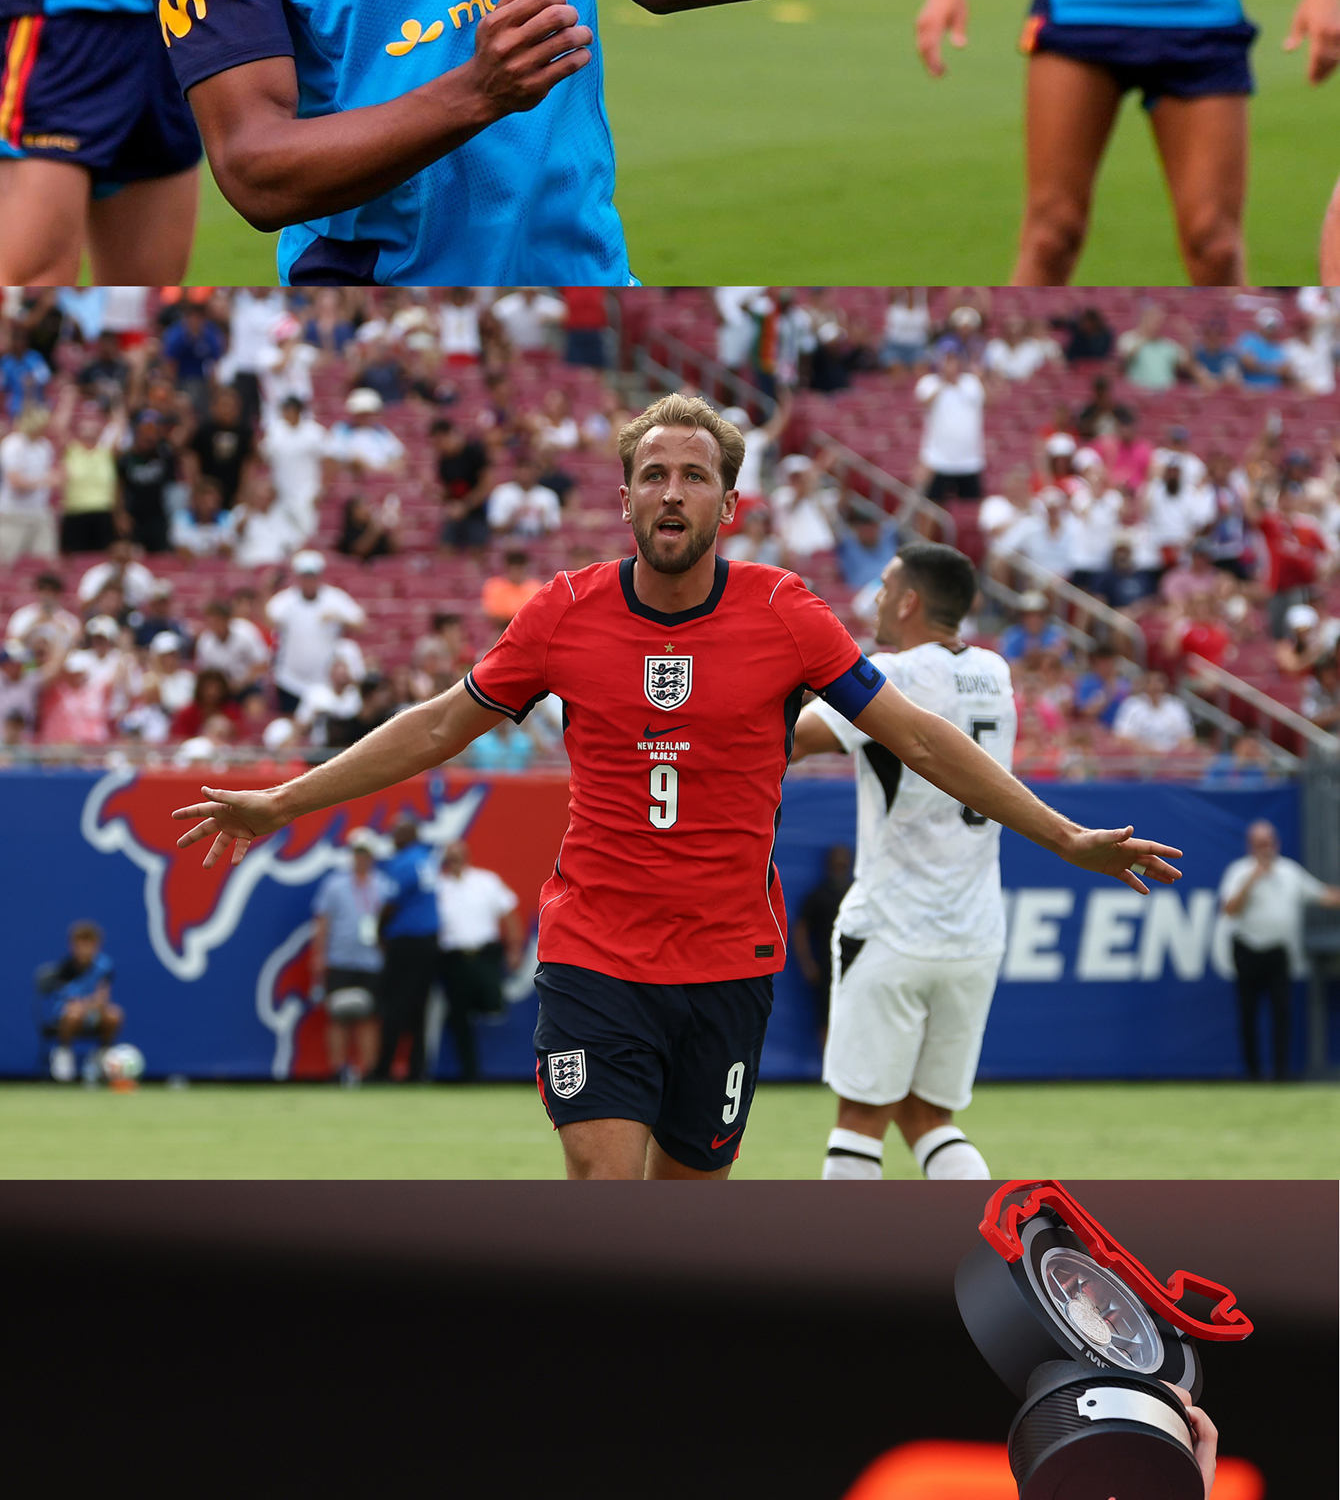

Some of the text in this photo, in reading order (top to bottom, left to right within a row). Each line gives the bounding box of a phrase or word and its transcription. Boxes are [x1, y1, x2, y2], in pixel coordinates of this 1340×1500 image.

[851, 659, 881, 690] C
[637, 742, 690, 751] NEW ZEALAND
[648, 763, 679, 829] 9
[721, 1061, 746, 1125] 9
